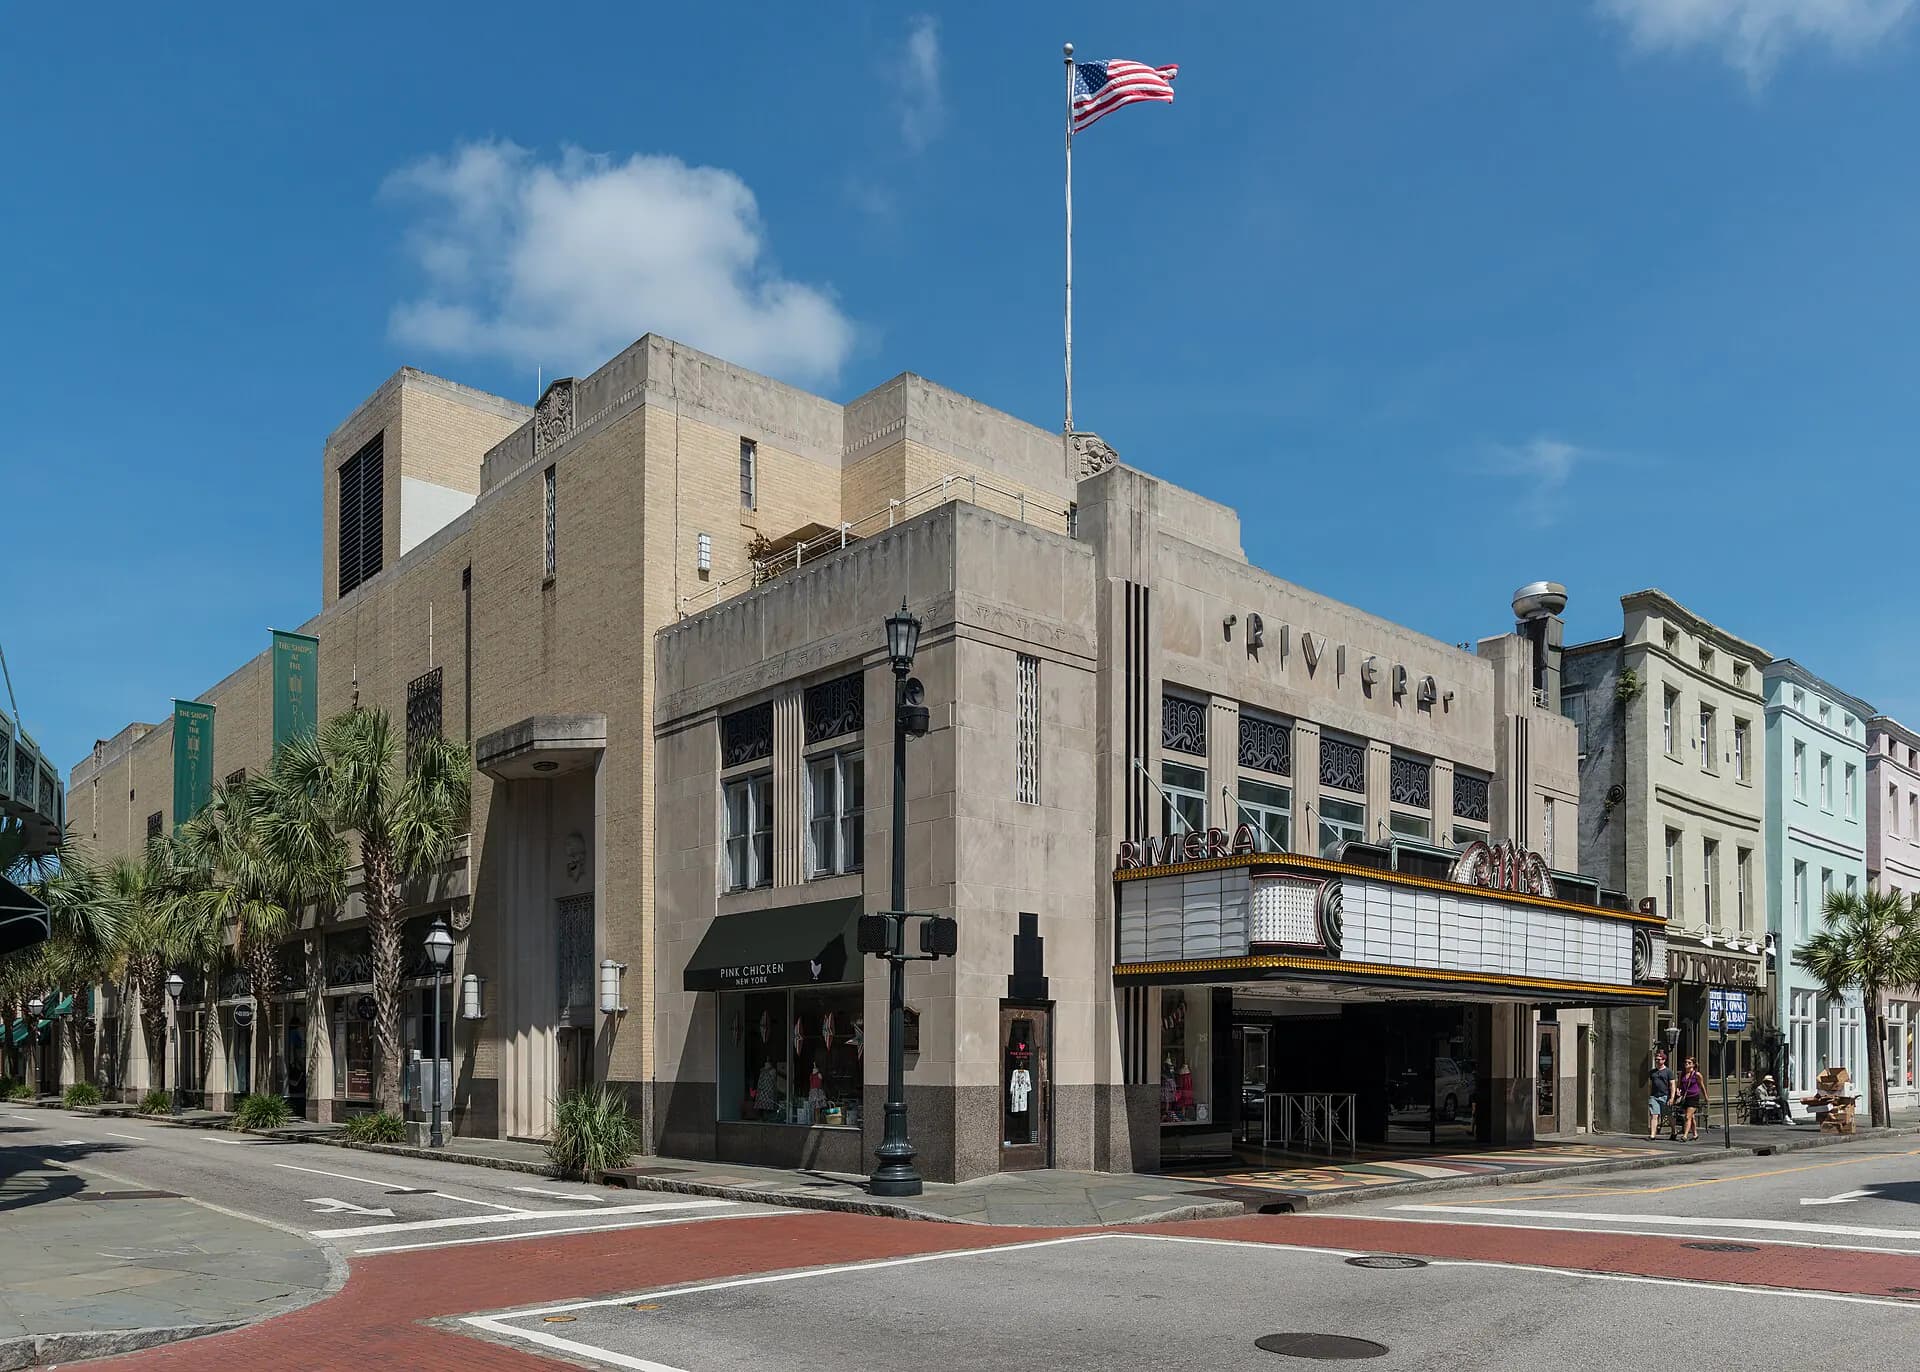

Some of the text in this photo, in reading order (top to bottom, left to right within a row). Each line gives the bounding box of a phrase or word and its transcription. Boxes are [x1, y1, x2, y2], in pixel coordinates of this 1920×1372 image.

[279, 641, 312, 654] THE SHOPS
[1247, 612, 1438, 707] RIVIERA
[180, 710, 209, 720] THE SHOPS
[189, 726, 200, 734] THE
[1119, 822, 1260, 869] RIVIERA
[720, 963, 784, 978] PINK CHICKEN
[1690, 954, 1737, 985] TOWNE
